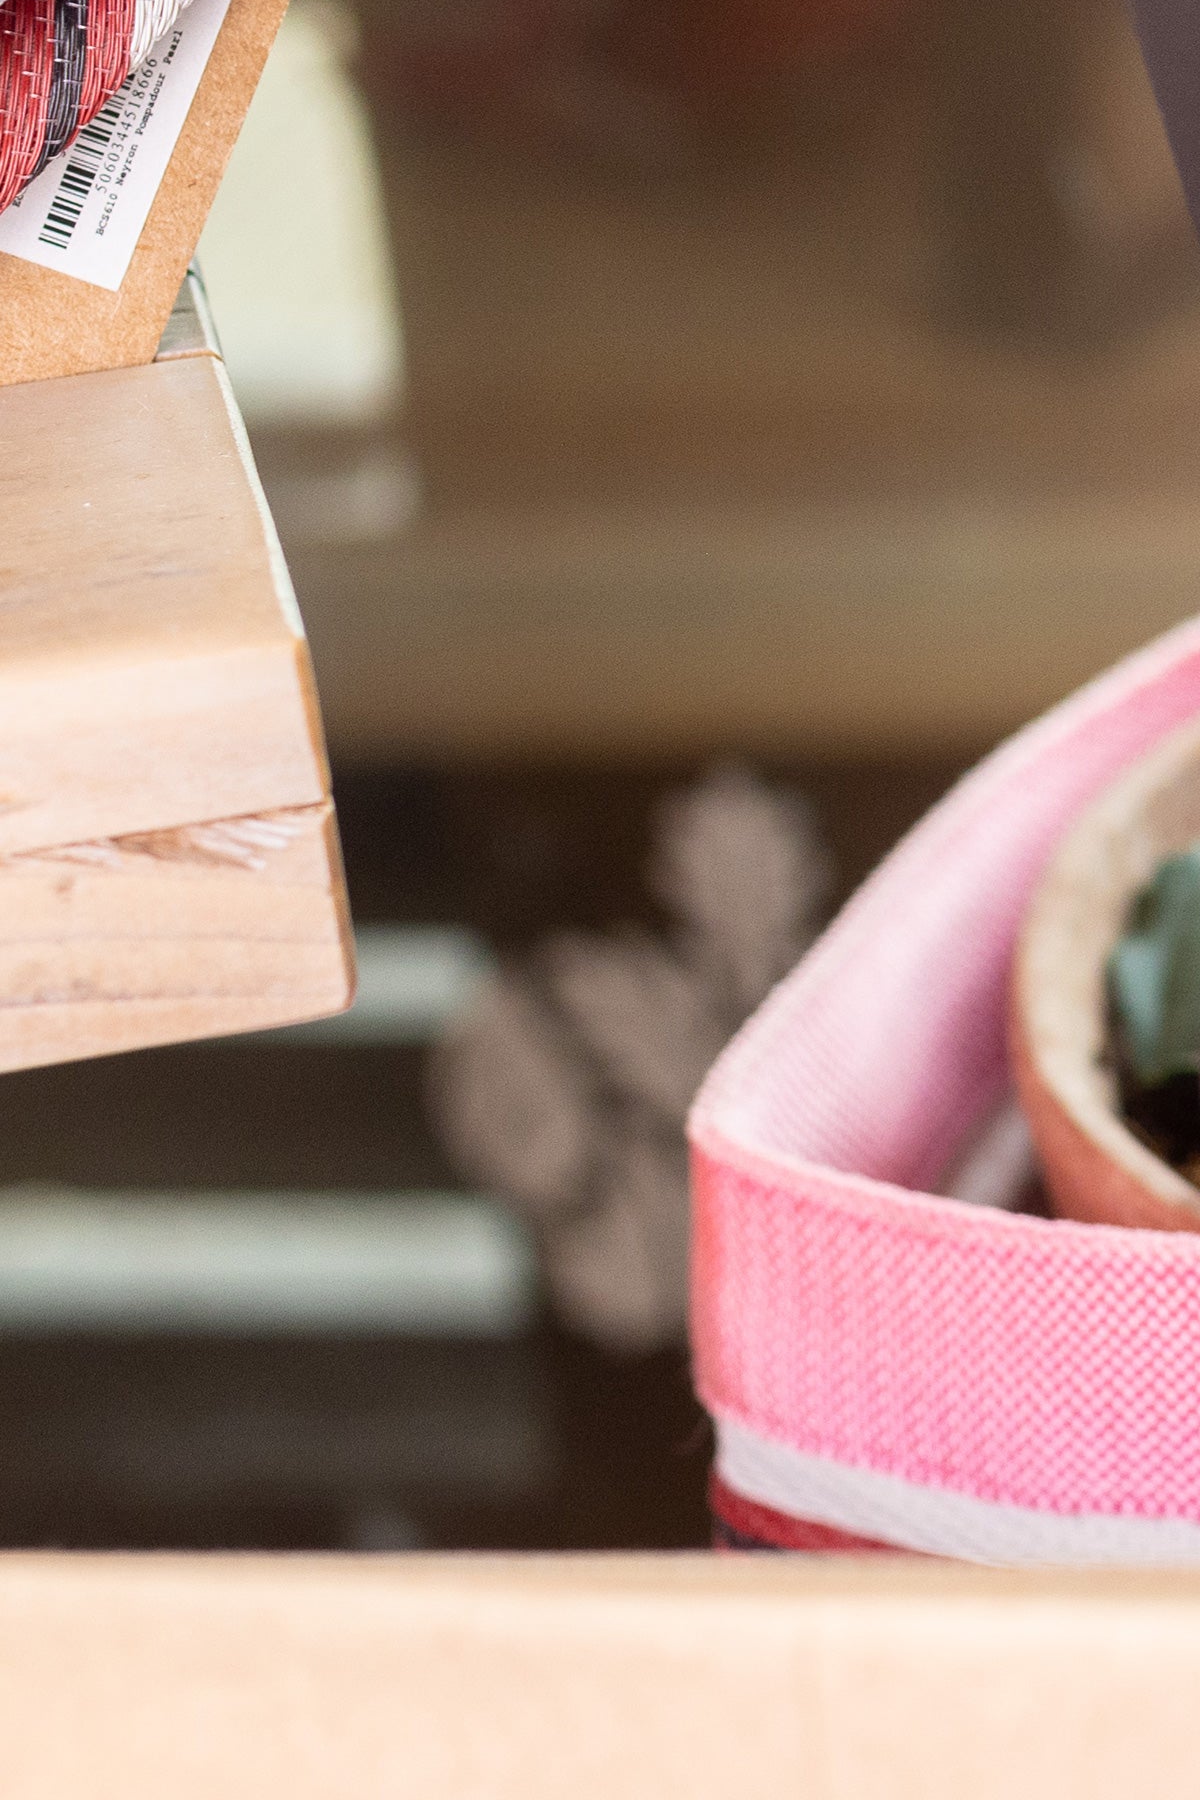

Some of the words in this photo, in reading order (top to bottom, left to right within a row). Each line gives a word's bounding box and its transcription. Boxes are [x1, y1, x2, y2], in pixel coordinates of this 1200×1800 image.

[95, 193, 118, 236] BCS610
[117, 142, 138, 187] Neyron
[135, 73, 166, 136] Pompadour
[162, 29, 184, 66] Pearl
[96, 57, 158, 193] 5060344518666
